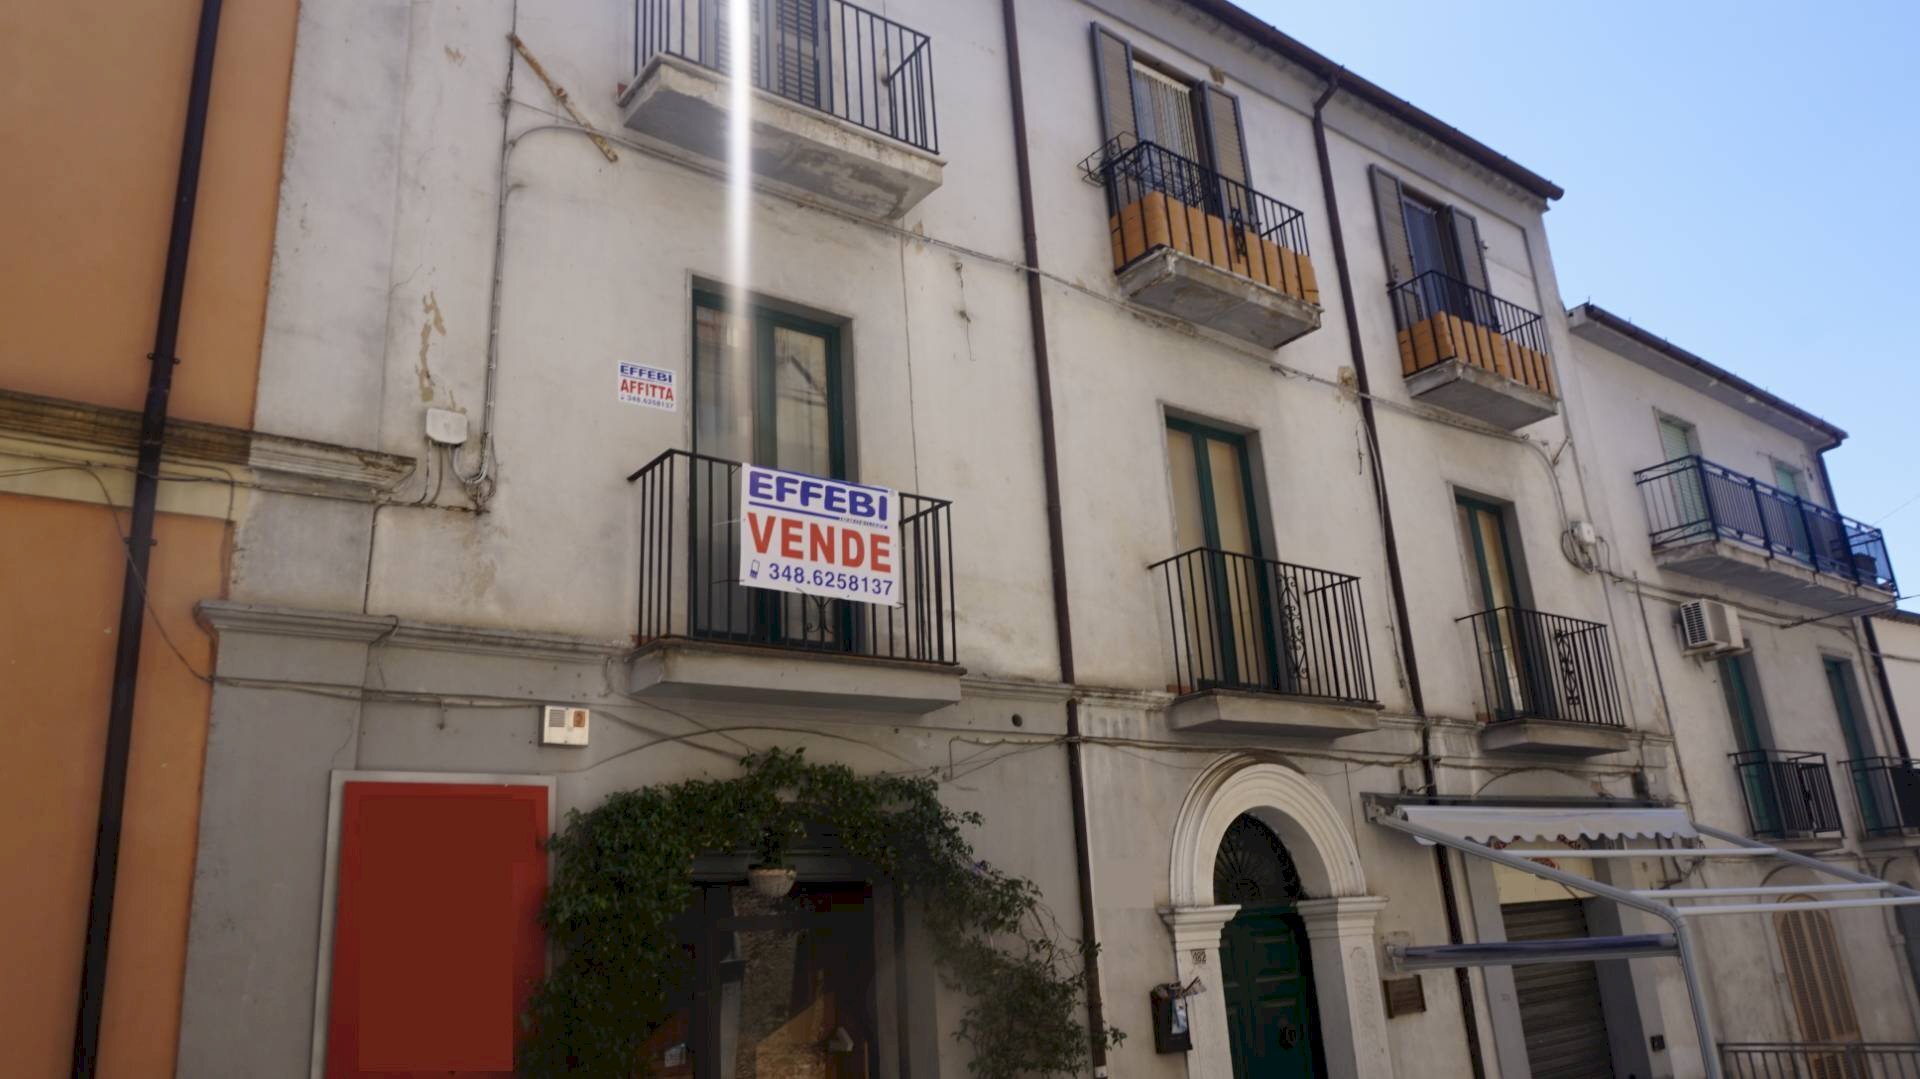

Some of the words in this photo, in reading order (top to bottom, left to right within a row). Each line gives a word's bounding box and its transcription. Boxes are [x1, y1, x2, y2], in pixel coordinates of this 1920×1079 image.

[620, 365, 672, 383] EFFEBI
[621, 379, 674, 401] AFFITTA
[749, 471, 887, 521] EFFEBI
[747, 512, 891, 573] VENDE
[769, 563, 893, 596] 348.6258137
